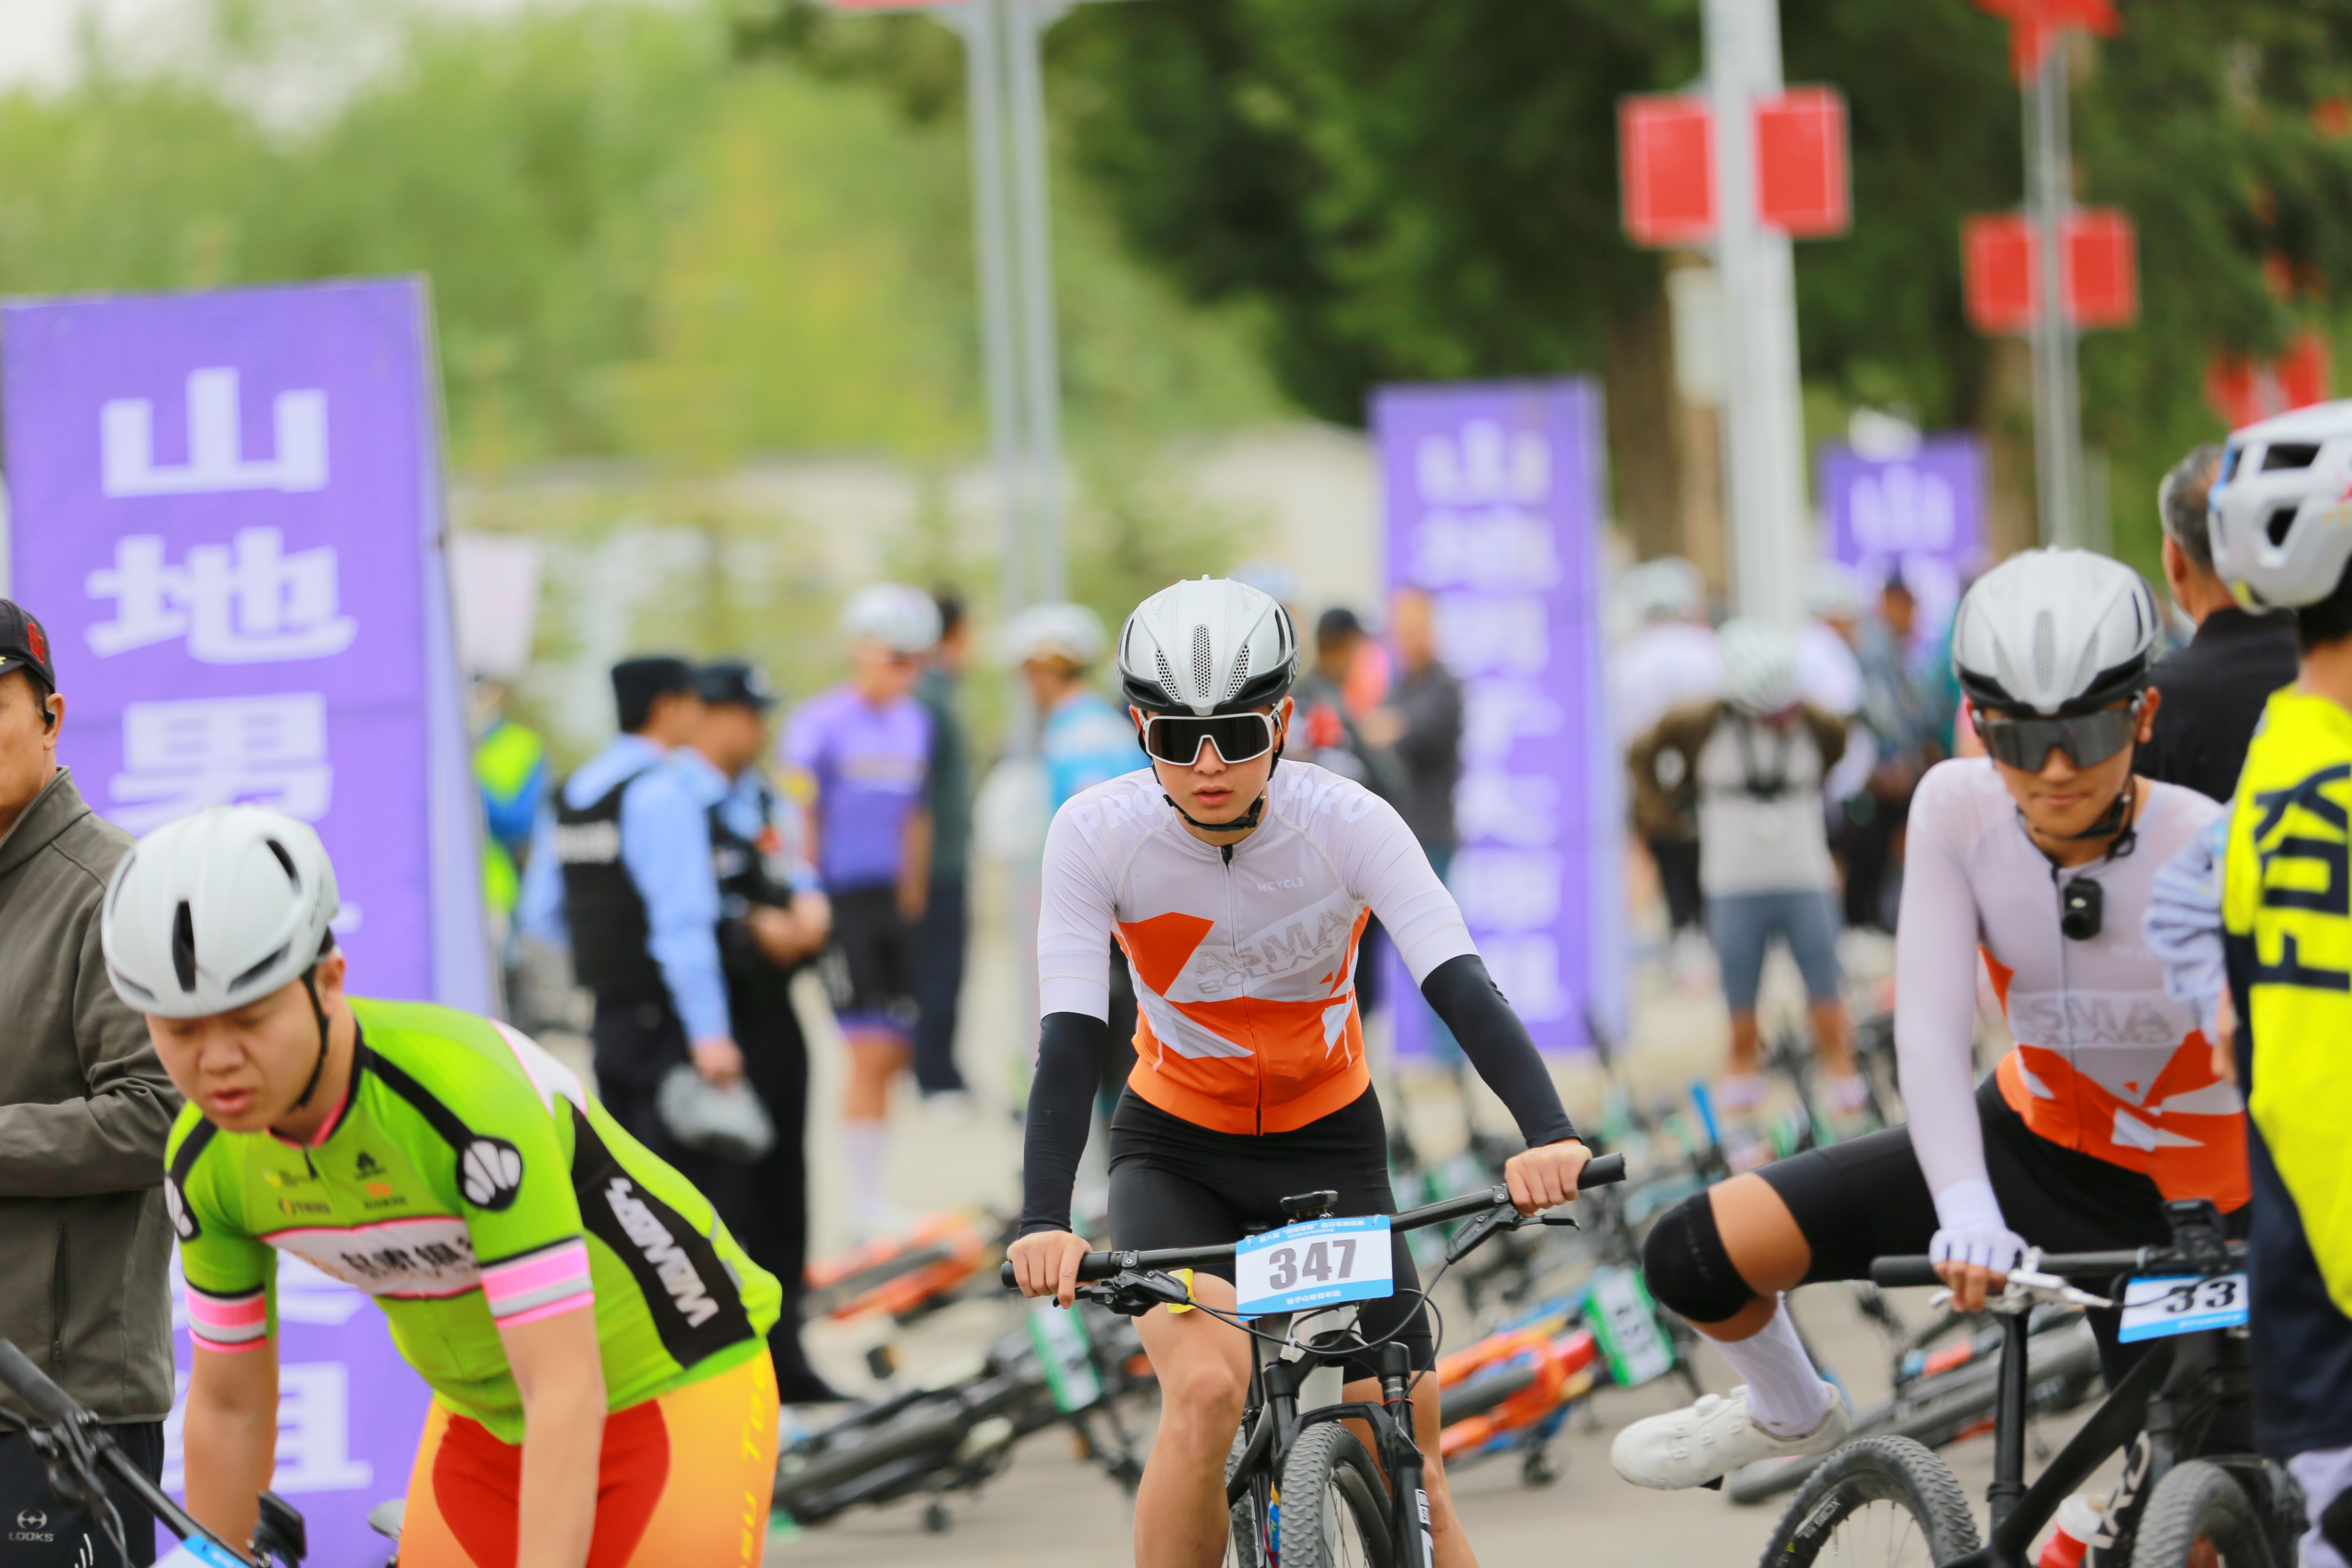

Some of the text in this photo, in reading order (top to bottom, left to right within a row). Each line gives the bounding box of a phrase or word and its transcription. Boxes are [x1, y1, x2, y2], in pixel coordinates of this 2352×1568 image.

[1068, 783, 1162, 844] PRO
[1281, 774, 1377, 823] PRO
[1257, 878, 1305, 893] MCYCLE
[1195, 909, 1350, 981] ASMA
[1321, 1220, 1365, 1228] 自行车挑战赛
[1270, 1239, 1356, 1290] 347
[1287, 1290, 1341, 1305] 男子山地青年组
[9, 1532, 53, 1542] LOOKS
